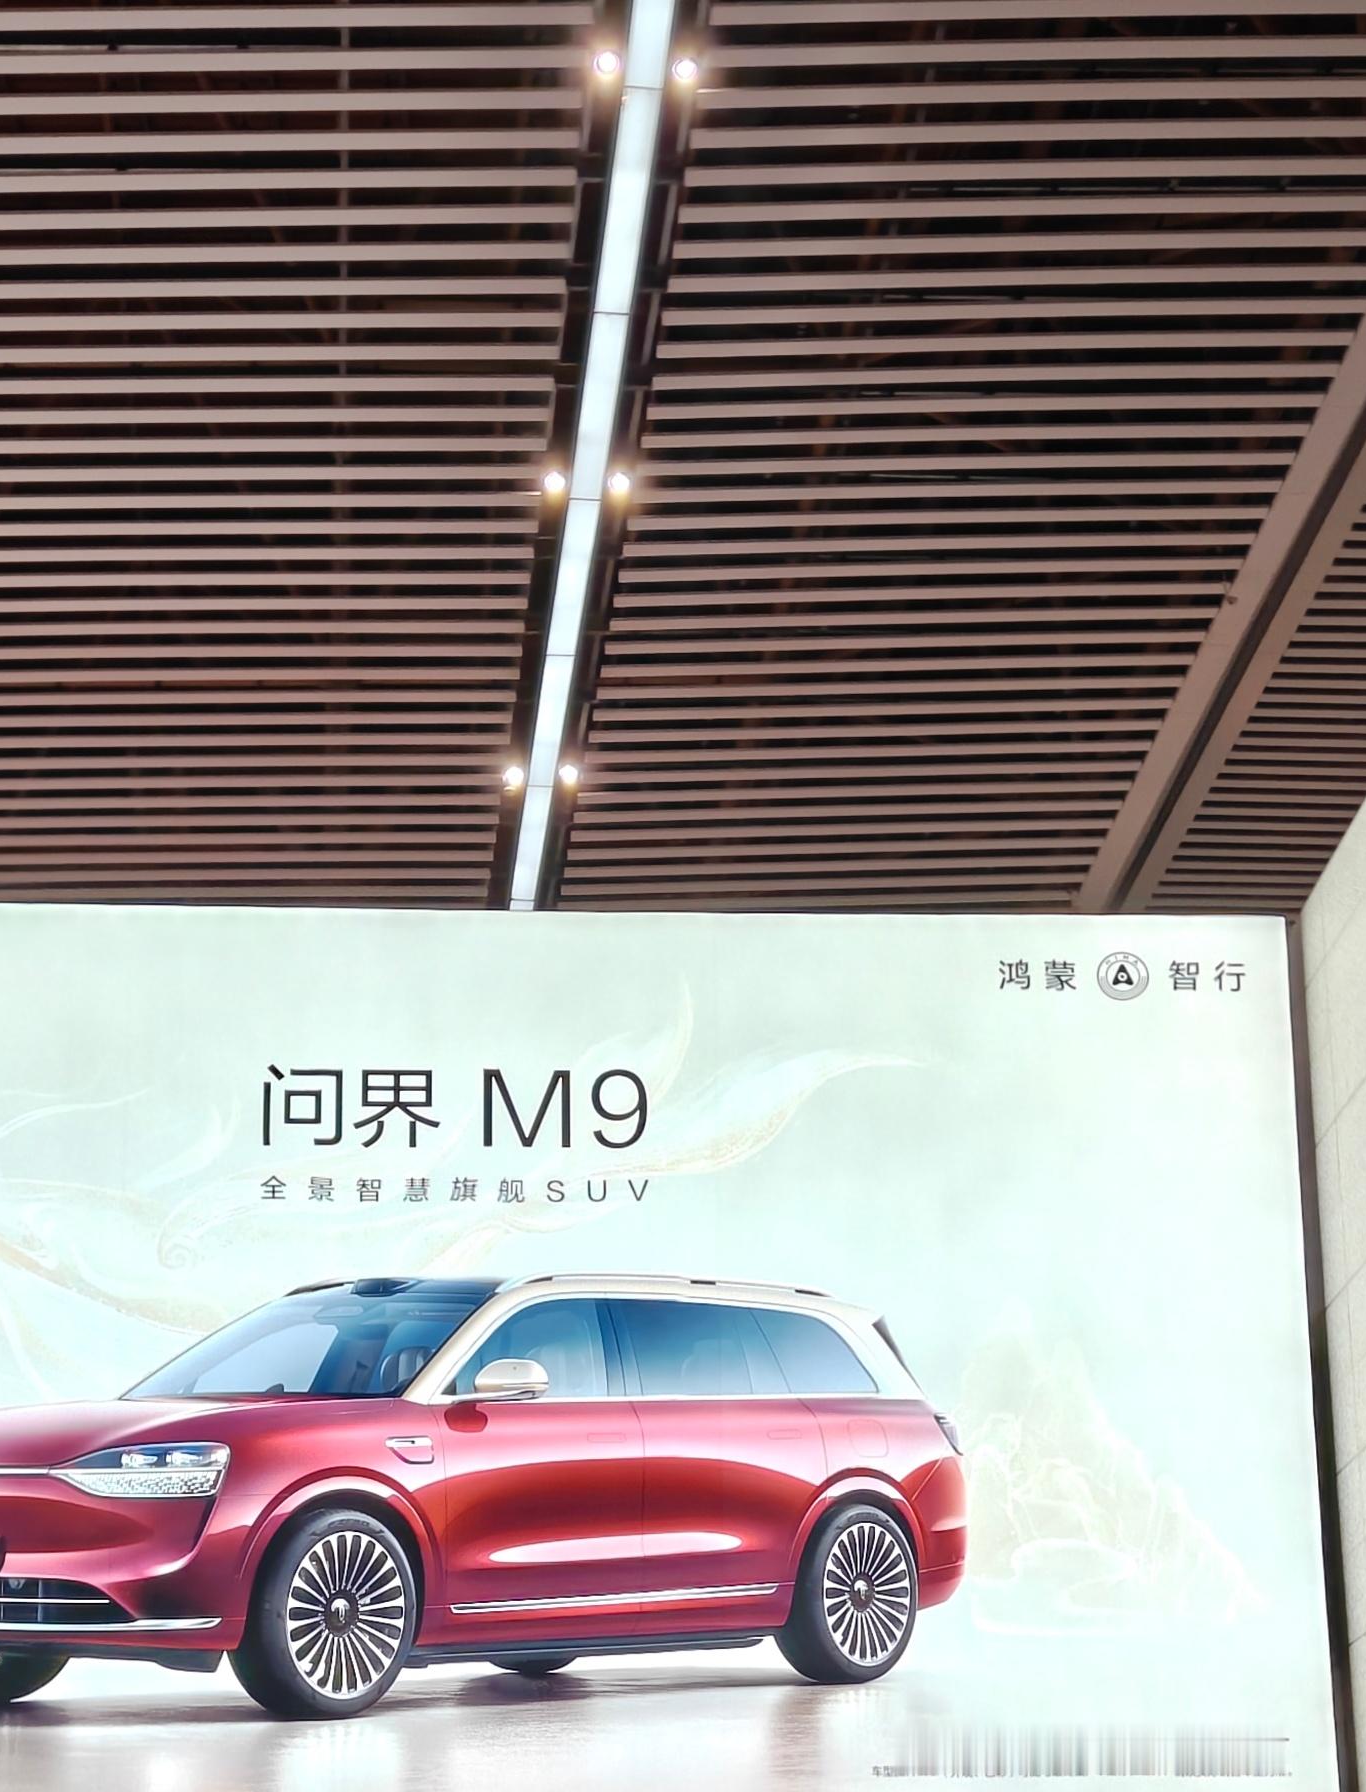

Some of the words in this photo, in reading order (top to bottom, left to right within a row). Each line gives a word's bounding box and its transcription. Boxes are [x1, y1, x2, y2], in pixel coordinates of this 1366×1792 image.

[998, 959, 1077, 991] 鸿蒙
[1168, 959, 1247, 992] 智行
[262, 1063, 441, 1148] 问界
[482, 1068, 649, 1149] M9
